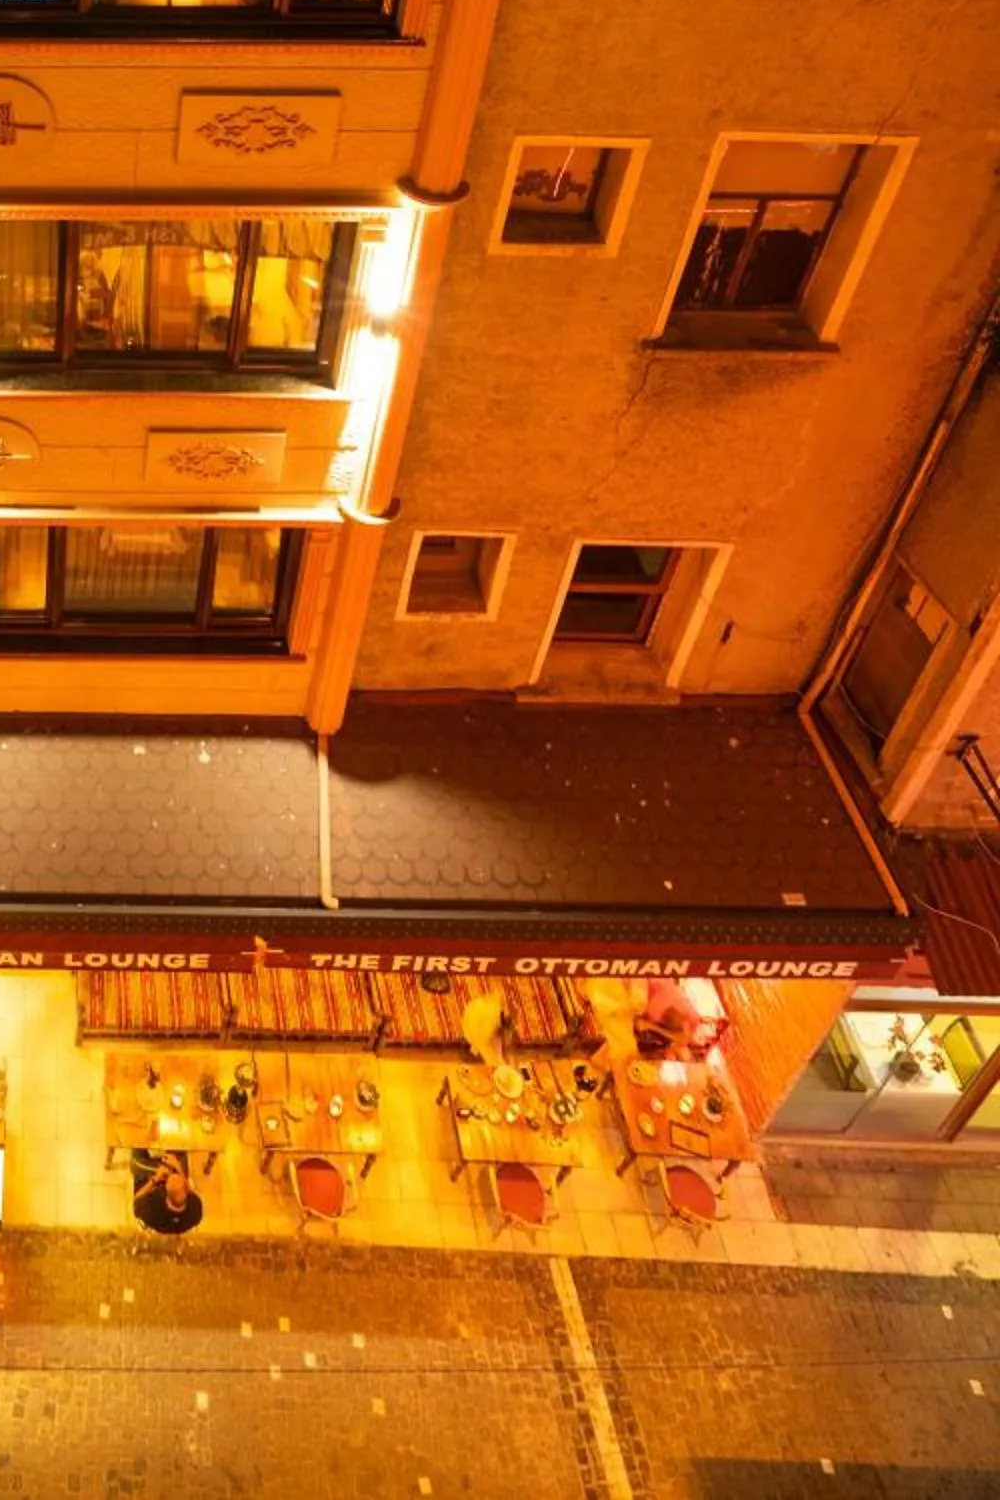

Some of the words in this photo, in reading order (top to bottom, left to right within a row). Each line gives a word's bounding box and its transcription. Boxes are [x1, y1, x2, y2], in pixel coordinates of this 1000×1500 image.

[63, 952, 211, 969] LOUNGE
[311, 953, 381, 970] THE
[391, 955, 497, 973] FIRST
[514, 957, 690, 975] OTTOMAN
[706, 960, 859, 977] LOUNGE
